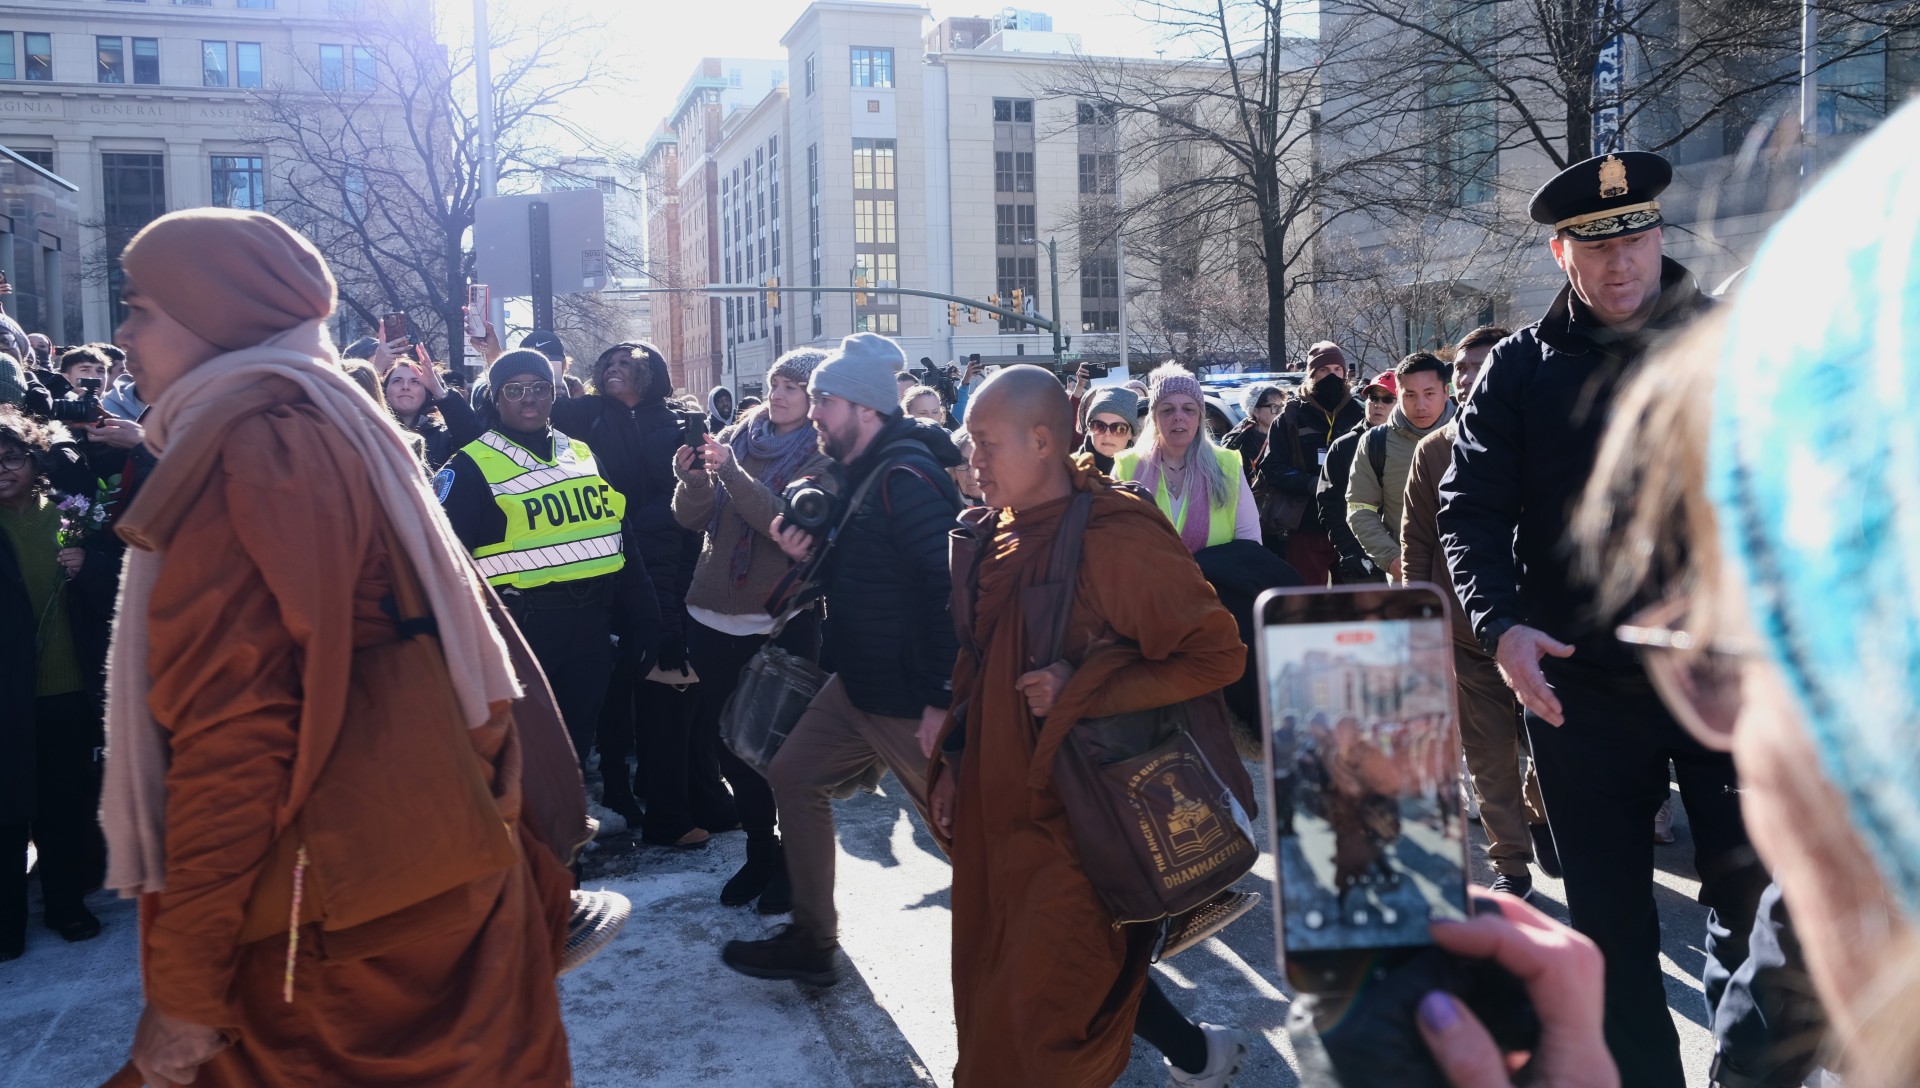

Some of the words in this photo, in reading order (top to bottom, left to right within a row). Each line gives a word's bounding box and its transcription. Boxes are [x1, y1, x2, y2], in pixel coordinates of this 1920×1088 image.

[0, 101, 53, 113] GINIA
[90, 103, 164, 116] GENERAL
[521, 484, 616, 530] POLICE
[1138, 812, 1159, 852] ANCIE
[1153, 853, 1167, 872] THE
